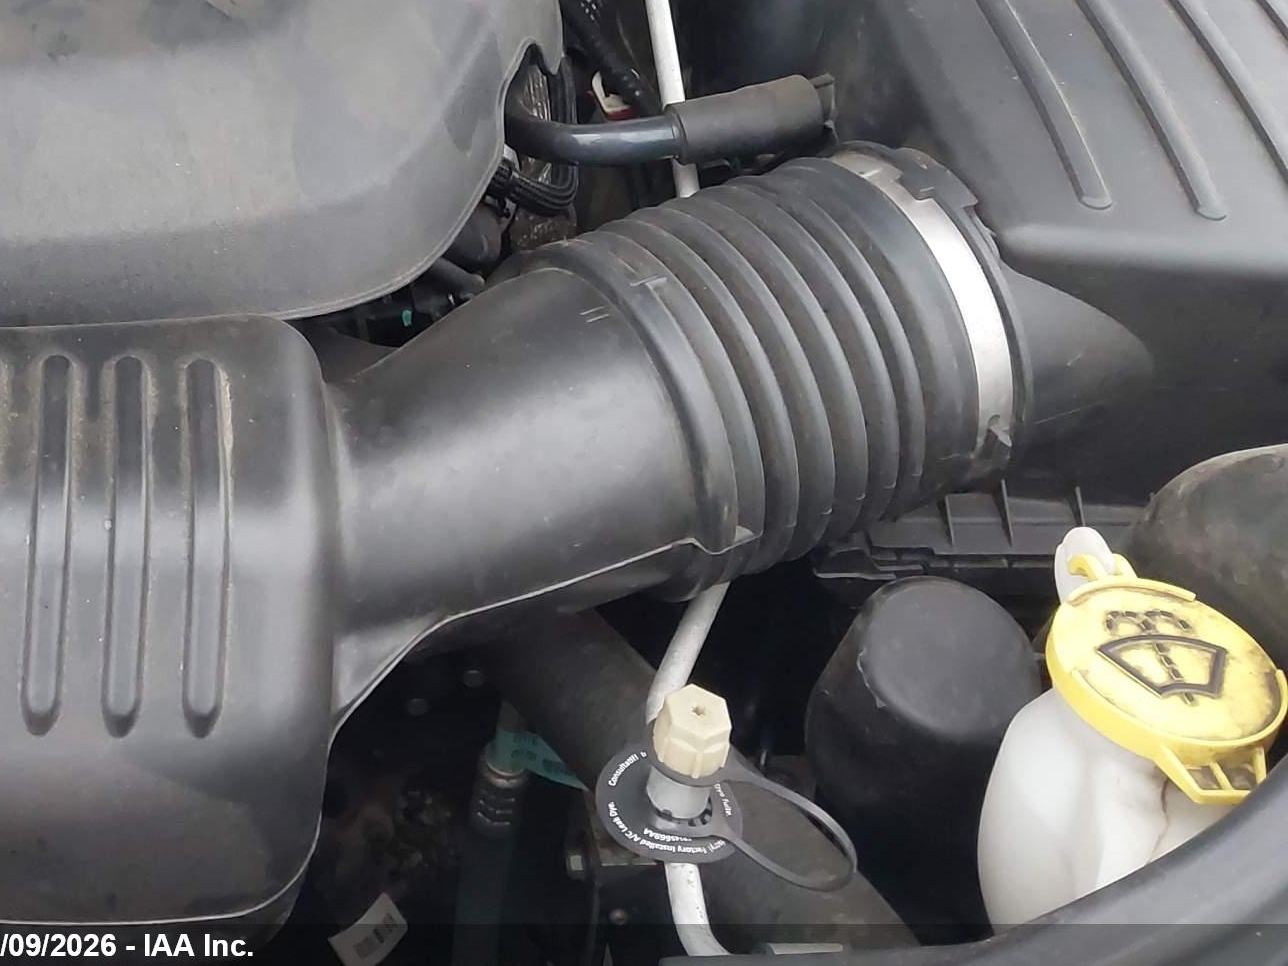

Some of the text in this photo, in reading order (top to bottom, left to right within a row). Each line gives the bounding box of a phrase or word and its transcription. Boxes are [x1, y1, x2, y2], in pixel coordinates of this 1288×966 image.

[612, 816, 629, 833] Leak
[624, 830, 642, 842] A/C
[639, 839, 676, 853] Installed
